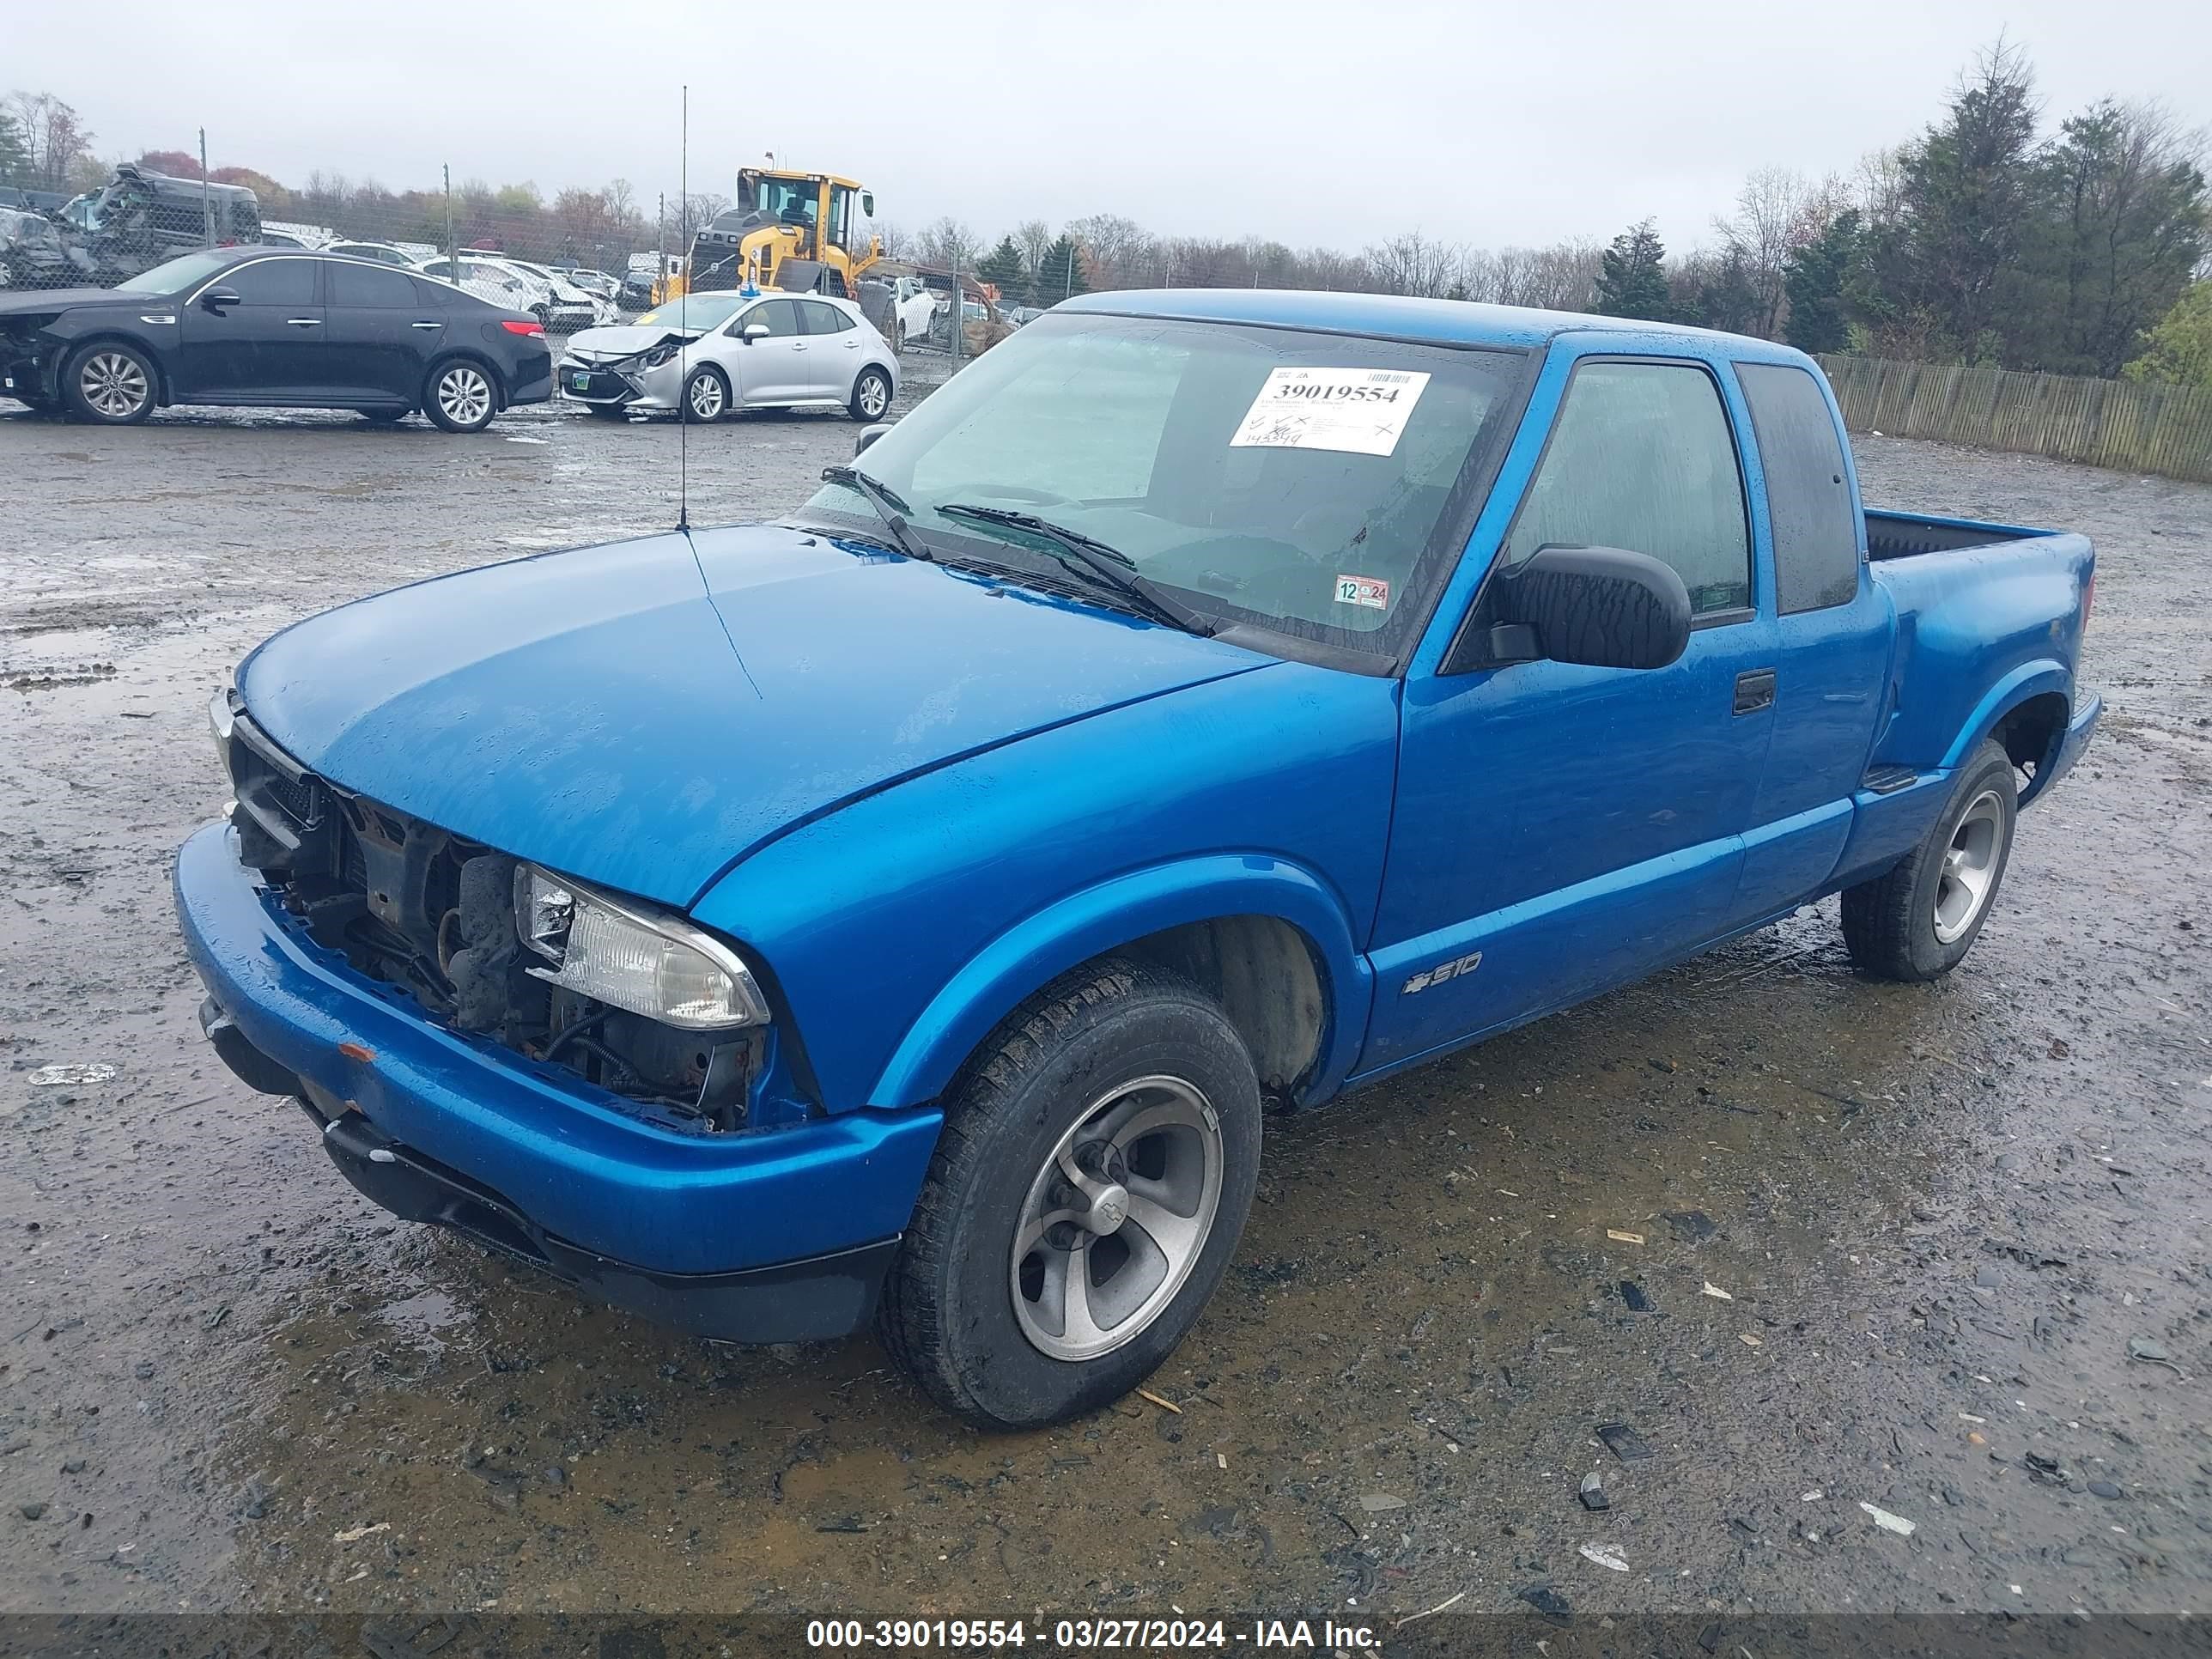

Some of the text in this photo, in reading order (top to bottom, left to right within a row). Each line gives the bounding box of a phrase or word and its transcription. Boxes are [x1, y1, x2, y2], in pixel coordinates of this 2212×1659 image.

[1273, 384, 1399, 404] 39019554
[1340, 582, 1386, 599] 12 24
[1430, 951, 1483, 987] S10
